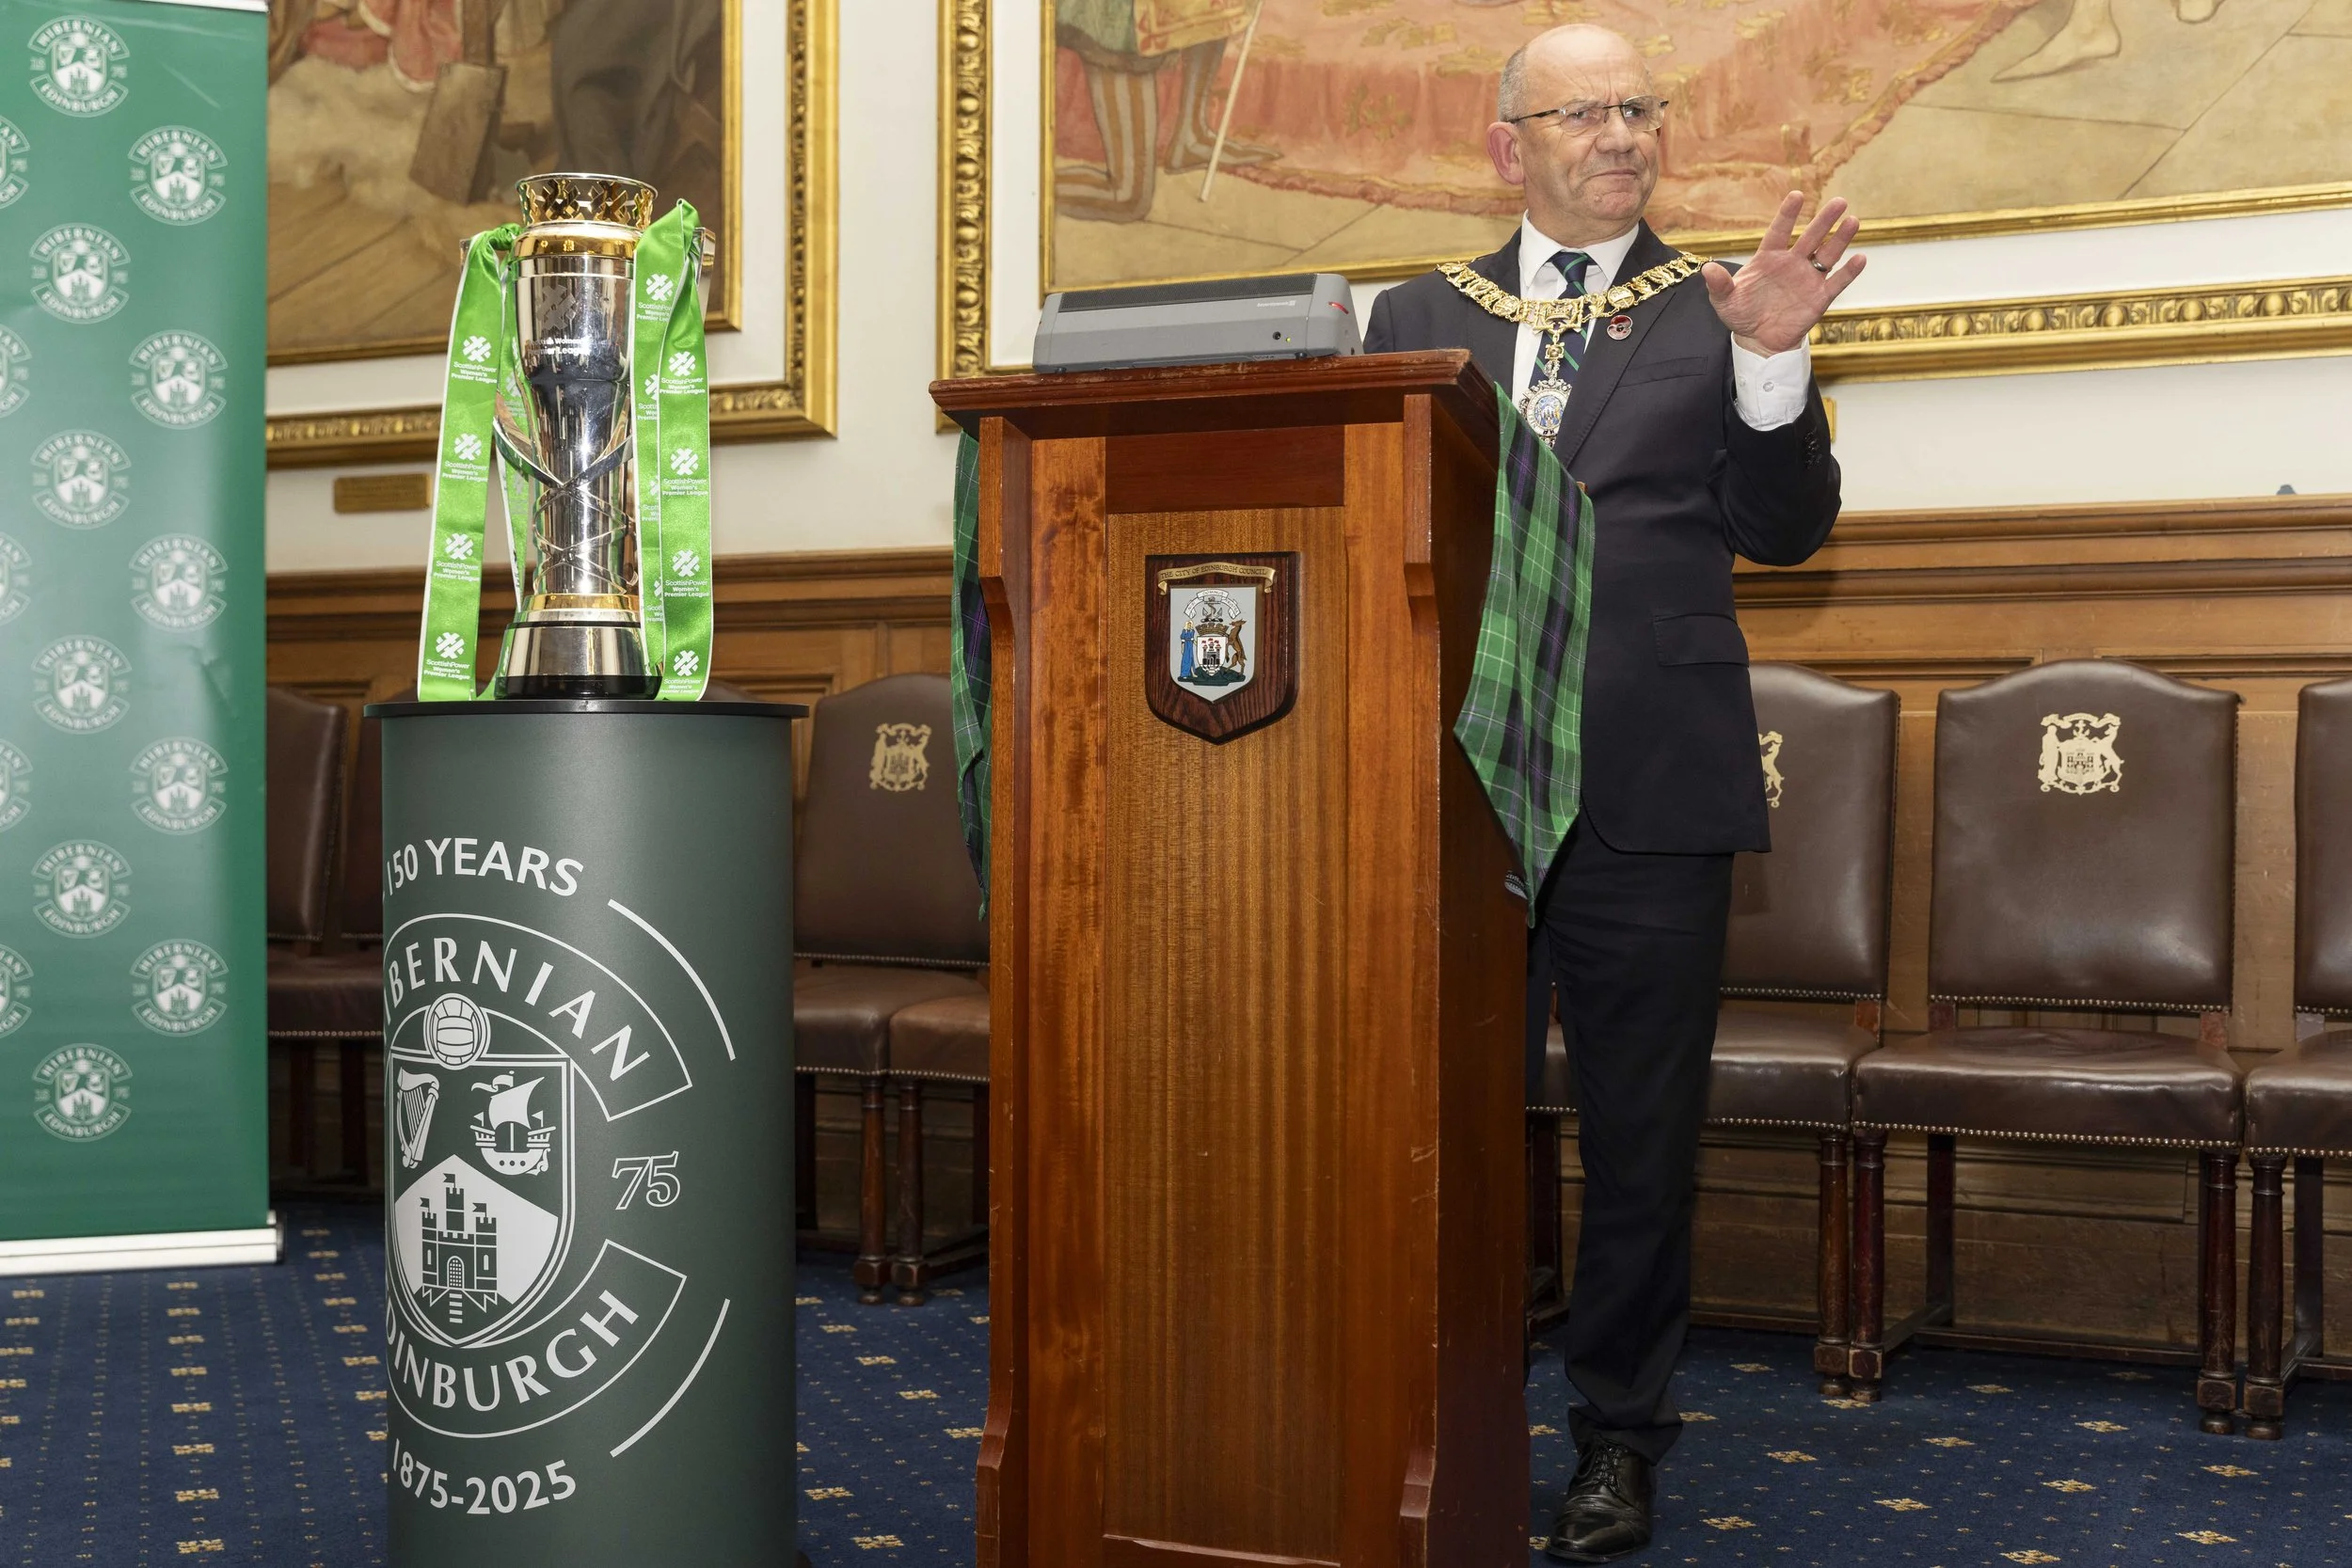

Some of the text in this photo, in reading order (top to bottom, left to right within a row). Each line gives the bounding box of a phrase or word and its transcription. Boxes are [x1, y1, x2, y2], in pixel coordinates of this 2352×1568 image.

[1191, 566, 1200, 575] OF
[1200, 563, 1238, 573] EDINBURGH
[1238, 567, 1267, 576] COUNCIL
[387, 837, 583, 896] 150 YEARS
[612, 1150, 681, 1211] 75
[386, 1290, 640, 1412] DINBURGH
[392, 1438, 577, 1514] 1875-2025
